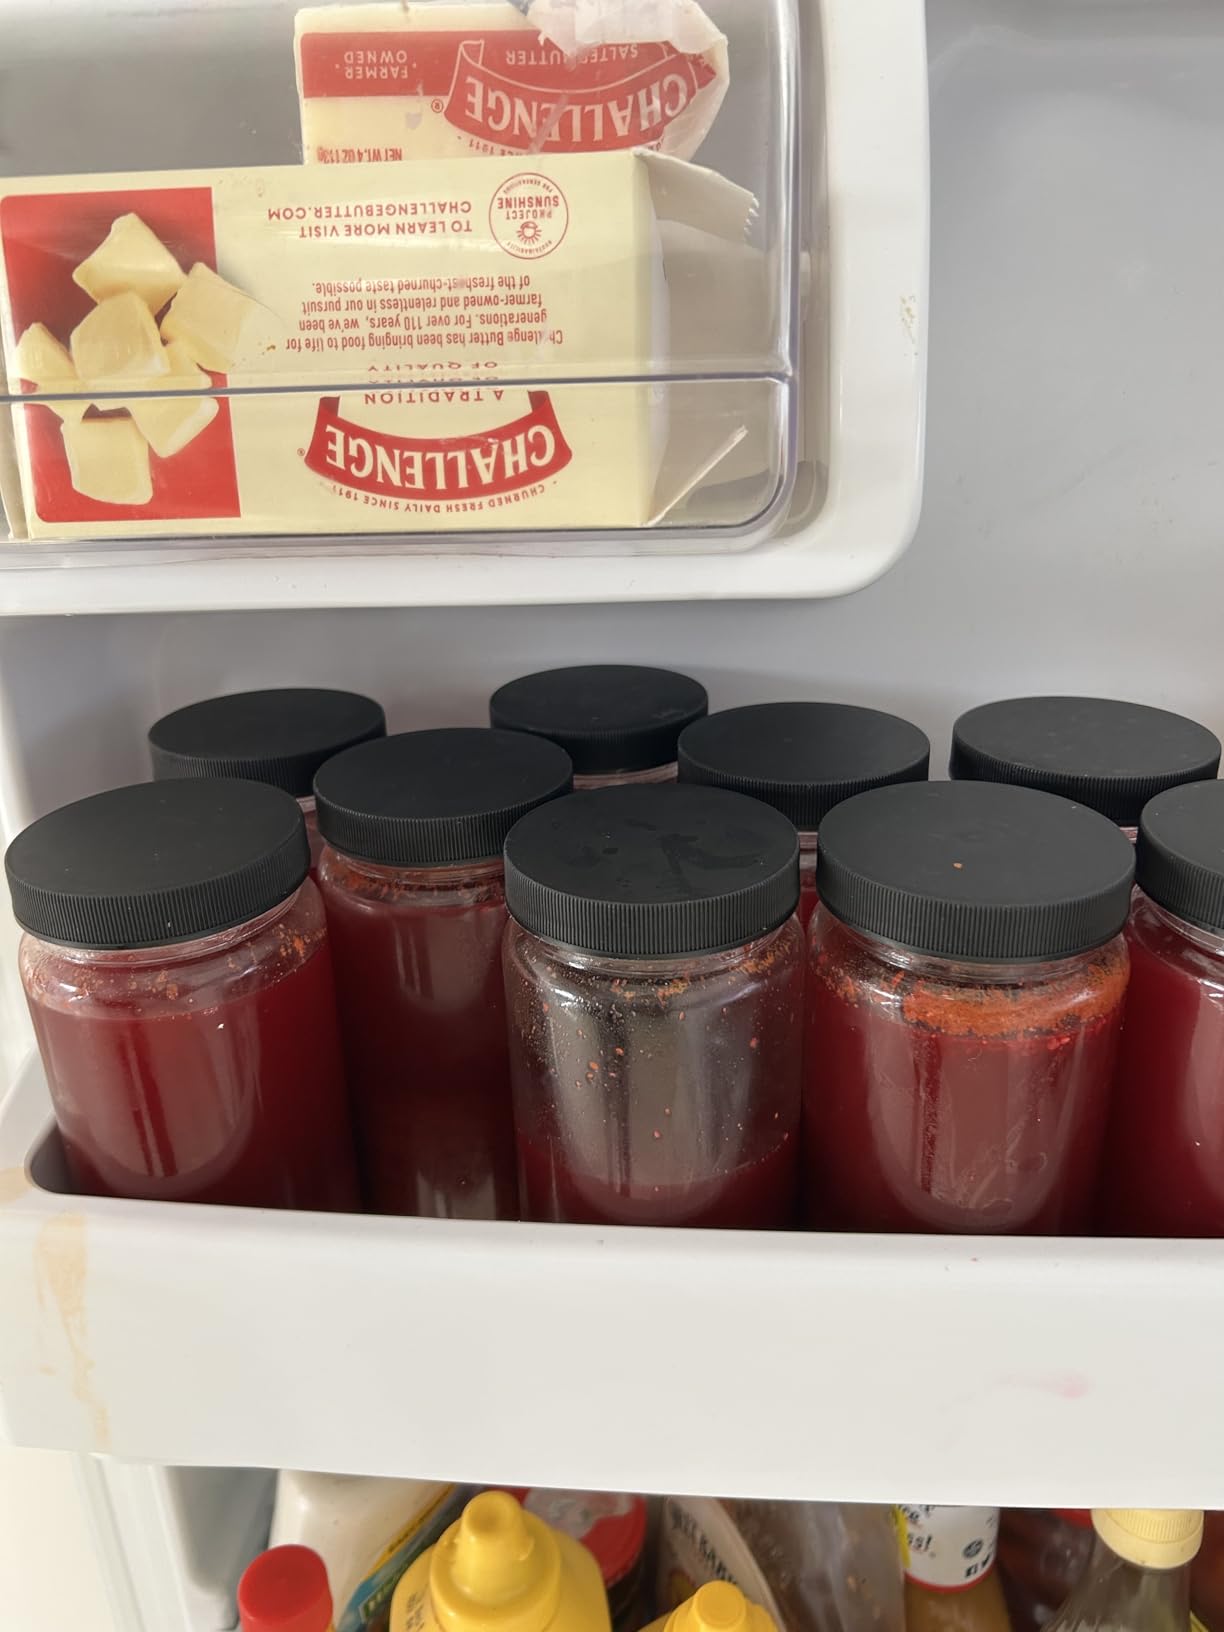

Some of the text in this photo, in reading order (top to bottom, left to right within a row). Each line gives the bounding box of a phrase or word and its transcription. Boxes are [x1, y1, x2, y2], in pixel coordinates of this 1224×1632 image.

[344, 50, 407, 64] OWNED
[344, 66, 408, 79] FARMER
[465, 74, 688, 141] CHALLENGE
[342, 149, 355, 163] OZ
[357, 149, 363, 162] 4
[384, 148, 402, 161] NET
[497, 196, 559, 209] SUNSHINE
[267, 201, 472, 220] CHALLENGEBUTTER.COM
[506, 209, 552, 220] PROJECT
[298, 219, 472, 238] TO LEARN MORE VISIT
[312, 275, 530, 296] of the freshst-churned taste possible.
[302, 293, 542, 315] farmer-owned and relentless in our pursuit
[299, 309, 547, 333] generations. For over 110 years, we've been
[286, 328, 563, 352] Chllenge Butter has been bringing food to life for
[367, 362, 462, 372] QUALITY
[364, 390, 504, 404] A TRADITION
[325, 424, 555, 490] CHALLENGE
[364, 495, 399, 510] SINCE
[488, 484, 545, 508] CHURNED
[404, 503, 440, 513] DAILY
[446, 500, 483, 512] FRESH
